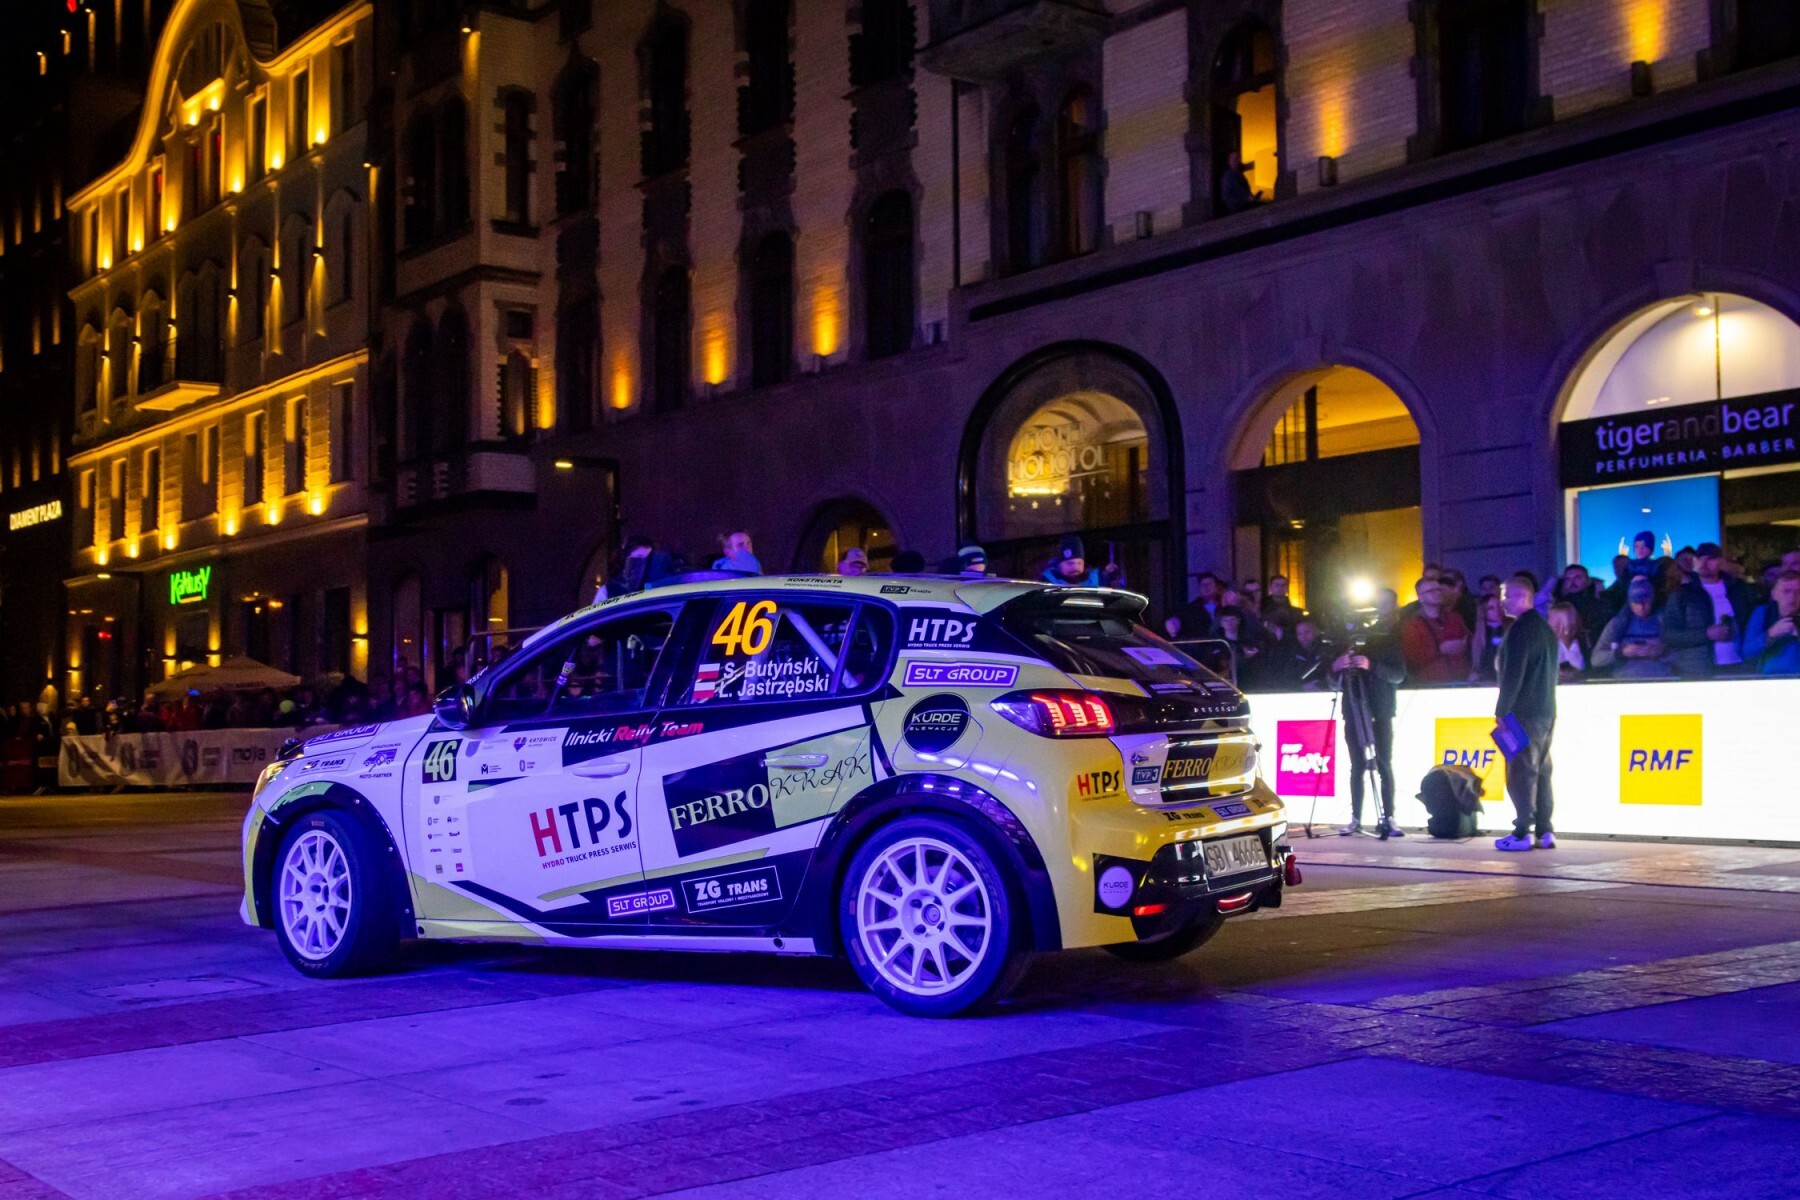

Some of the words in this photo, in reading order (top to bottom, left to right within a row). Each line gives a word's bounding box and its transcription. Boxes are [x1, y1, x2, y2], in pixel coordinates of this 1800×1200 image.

[1595, 403, 1795, 456] tigerandbear
[1007, 445, 1109, 482] MONOPOL
[1595, 449, 1708, 474] PERFUMERIA
[1721, 437, 1796, 459] BARBER
[712, 600, 777, 656] 46
[908, 618, 977, 643] HTPS
[723, 661, 737, 680] S.
[744, 656, 819, 681] Butyński
[913, 667, 943, 680] SLT
[946, 668, 1008, 681] GROUP
[737, 673, 830, 698] Jastrzębski
[564, 728, 615, 747] Ilnicki
[660, 721, 704, 738] Team
[320, 758, 346, 768] TRANS
[424, 740, 459, 783] 46
[1628, 749, 1694, 772] RMF
[1076, 769, 1120, 797] HTPS
[528, 790, 633, 857] HTPS
[1162, 811, 1181, 821] ZG
[542, 858, 566, 870] HYDRO
[566, 853, 588, 865] TRUCK
[588, 847, 610, 859] PRESS
[610, 841, 637, 854] SERWIS
[1206, 843, 1232, 872] SBI
[612, 899, 630, 912] SLT
[633, 893, 670, 909] GROUP
[694, 879, 722, 901] ZG
[726, 878, 768, 896] TRANS
